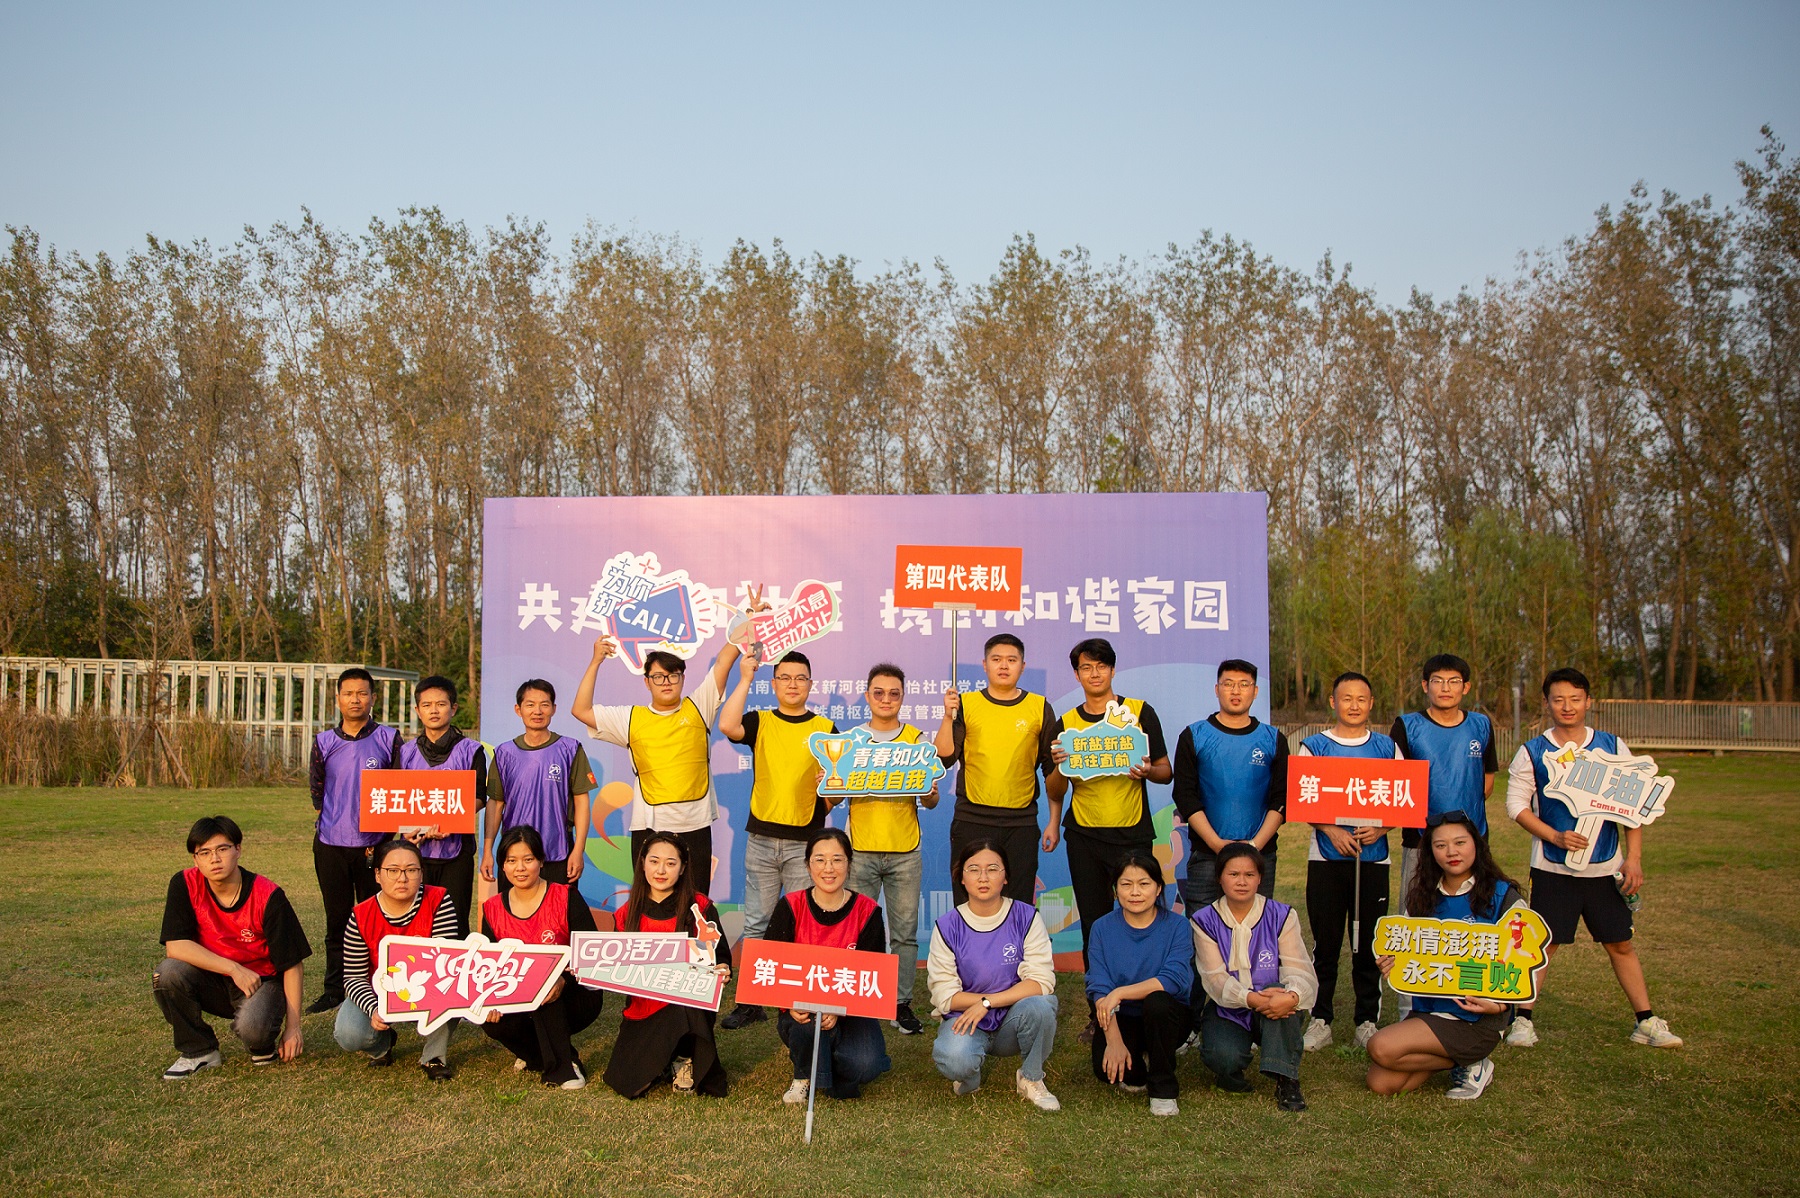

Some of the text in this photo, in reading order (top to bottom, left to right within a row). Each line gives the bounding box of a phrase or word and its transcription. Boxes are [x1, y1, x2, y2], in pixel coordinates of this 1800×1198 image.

[603, 566, 655, 602] 为你
[905, 563, 1010, 592] 第四代表队
[755, 589, 829, 642] 生命不息
[762, 610, 832, 661] 运动不止
[852, 747, 931, 768] 青春如火
[1073, 735, 1134, 752] 新盐新盐
[1069, 752, 1130, 769] 勇往直前
[845, 769, 927, 791] 超越自我
[1298, 775, 1415, 808] 第一代表队
[1564, 758, 1665, 818] 加油!
[369, 787, 466, 815] 第五代表队
[1590, 799, 1616, 812] Come
[1384, 923, 1500, 960] 激情澎湃
[752, 957, 883, 999] 第二代表队
[1402, 958, 1522, 995] 永不言败
